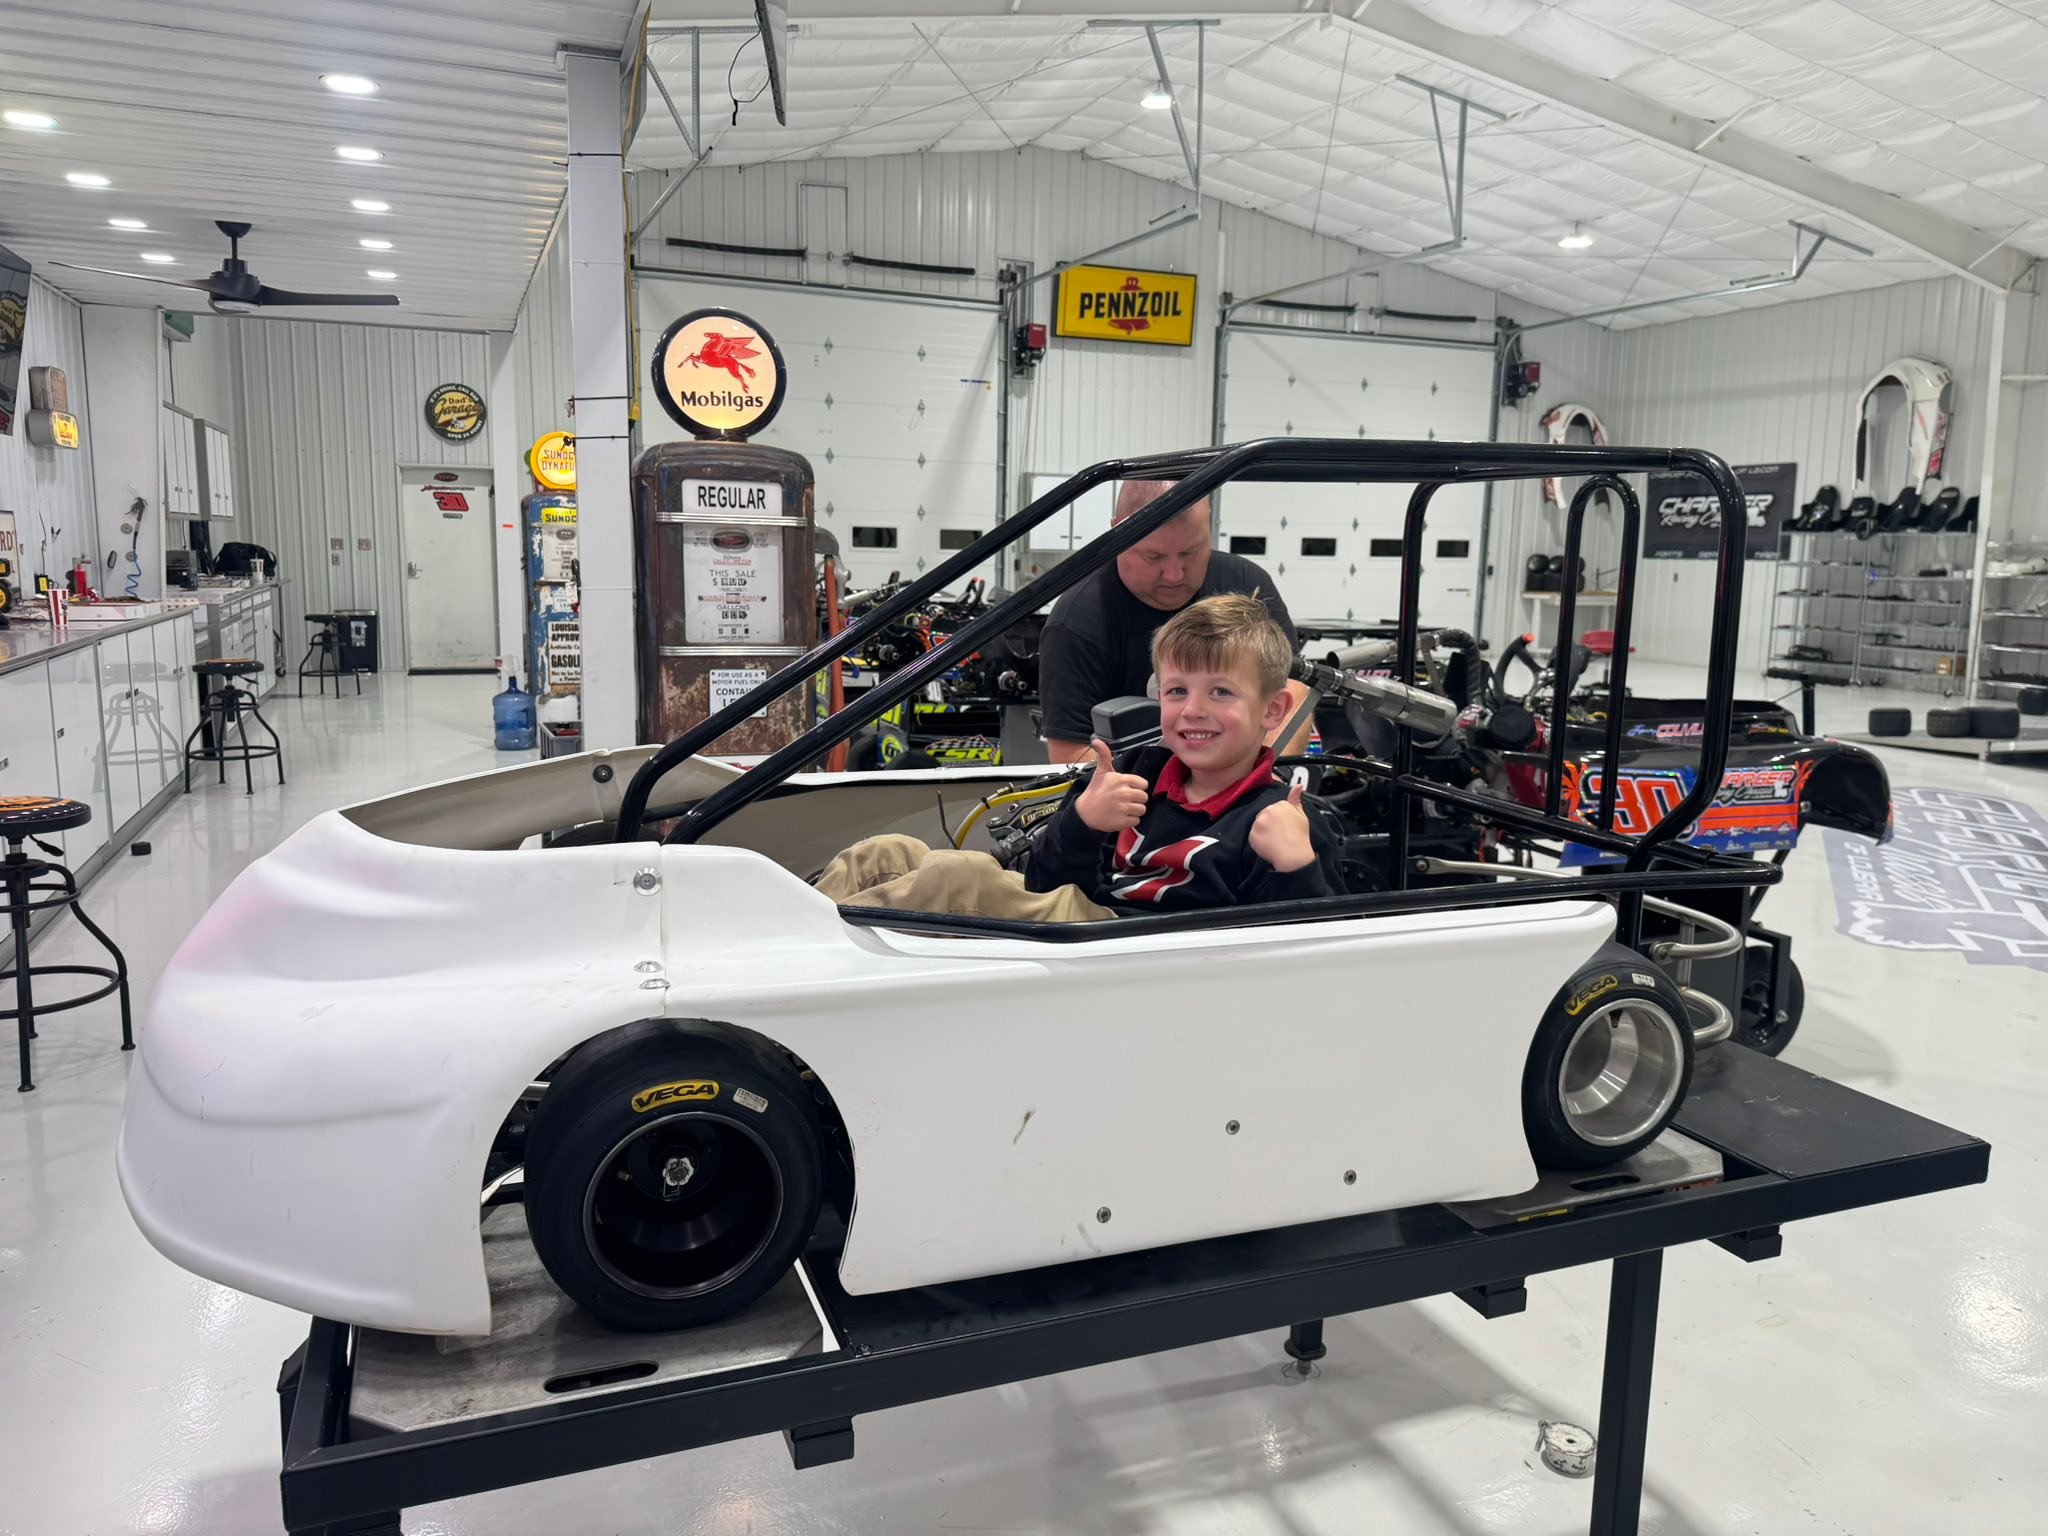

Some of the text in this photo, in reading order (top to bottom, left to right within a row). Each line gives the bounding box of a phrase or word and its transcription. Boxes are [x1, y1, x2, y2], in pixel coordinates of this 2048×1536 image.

[1079, 291, 1182, 318] PENNZOIL
[448, 396, 474, 404] Dad's
[458, 386, 470, 394] CALL
[470, 391, 480, 402] DAD
[681, 391, 764, 412] Mobilgas
[432, 397, 484, 417] Garage
[543, 449, 575, 460] SUNOC
[541, 460, 576, 471] DYNAFU
[432, 491, 470, 512] 30
[697, 485, 767, 510] REGULAR
[1659, 494, 1775, 514] CHARER
[545, 513, 577, 524] SUNOC
[1659, 511, 1699, 530] Racing
[709, 569, 757, 578] THIS SALE
[551, 622, 579, 632] LOUISIA
[551, 633, 580, 642] APPROV
[551, 653, 581, 668] GASOLI
[1566, 975, 1617, 1011] VEGA
[634, 1083, 716, 1108] VEGA
